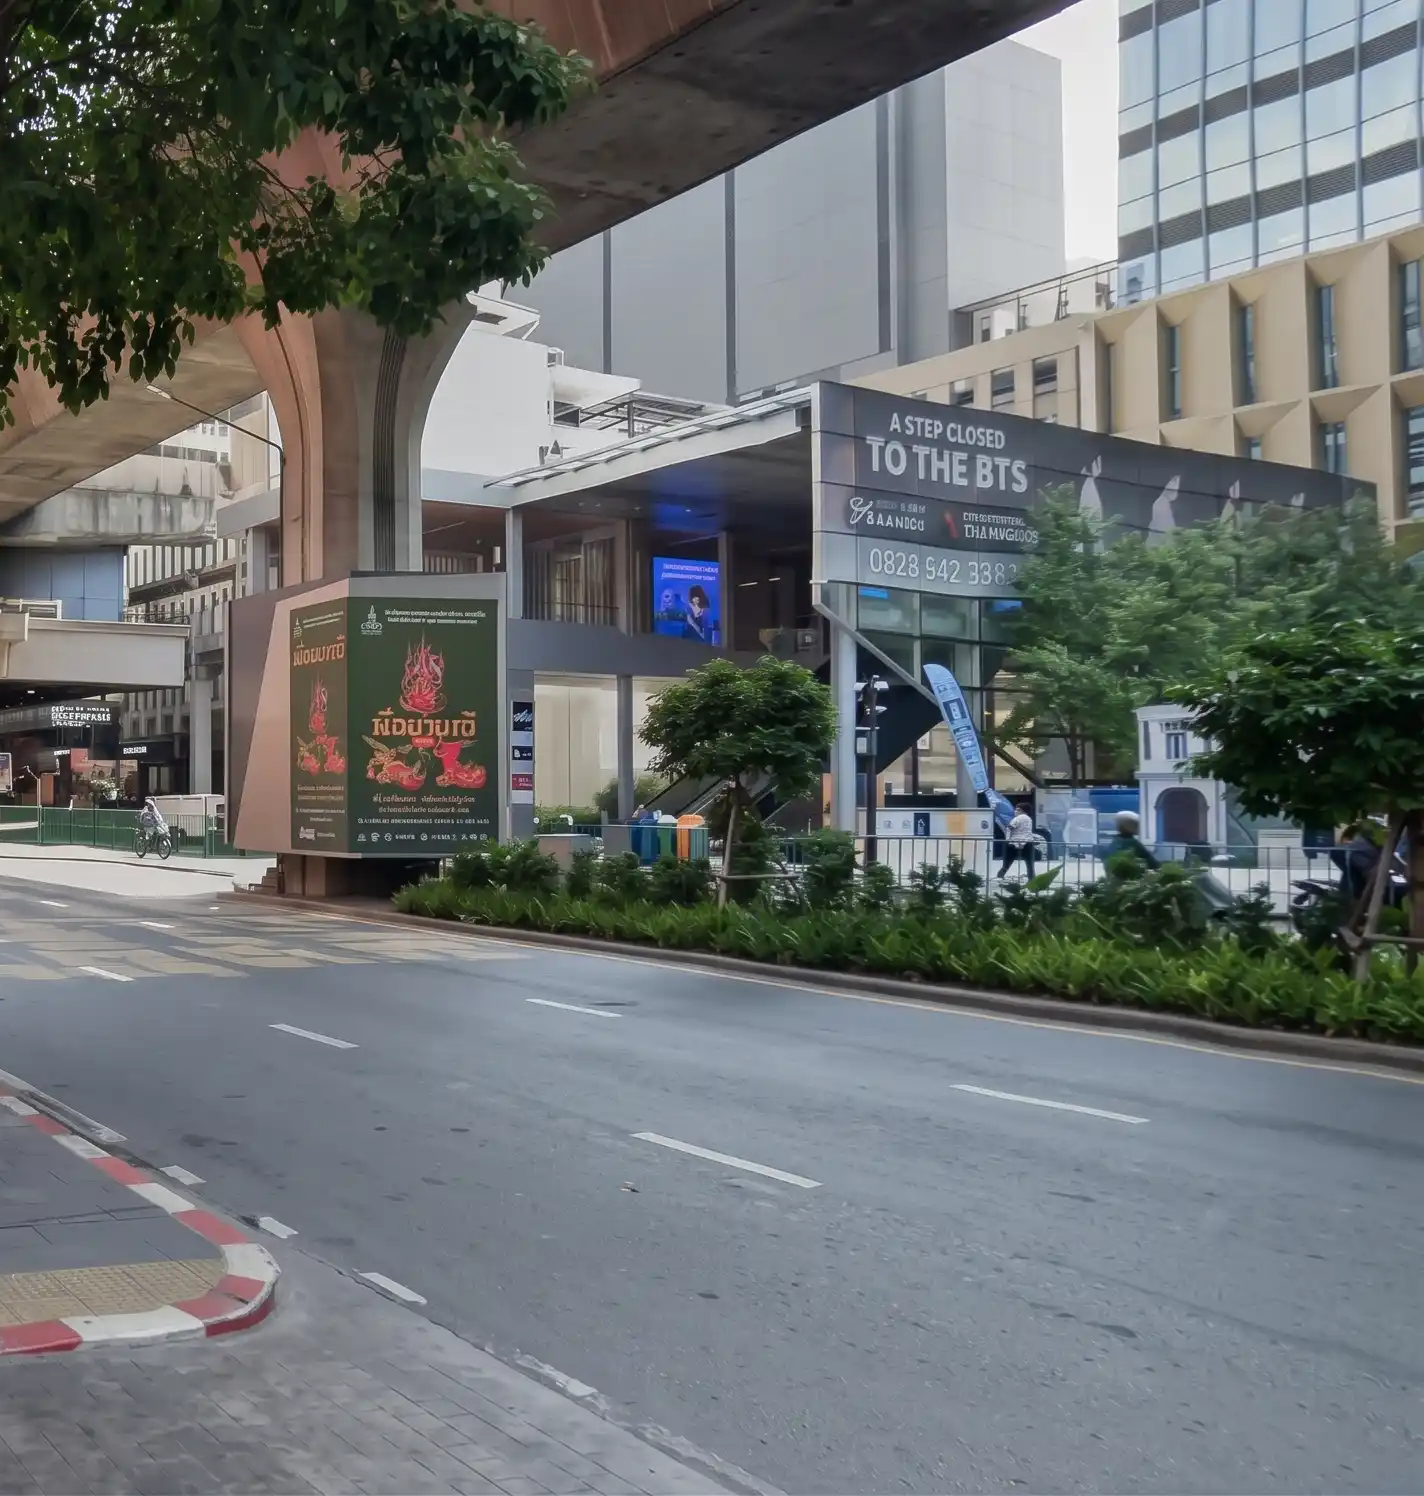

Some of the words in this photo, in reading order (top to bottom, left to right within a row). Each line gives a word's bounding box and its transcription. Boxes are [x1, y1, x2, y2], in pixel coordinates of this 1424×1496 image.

[889, 412, 901, 433] A
[904, 416, 943, 440] STEP
[946, 423, 1006, 450] CLOSED
[866, 436, 907, 476] TO
[912, 445, 969, 487] THE
[976, 454, 1028, 493] BTS
[869, 548, 920, 577] 0828
[925, 556, 962, 584] 942
